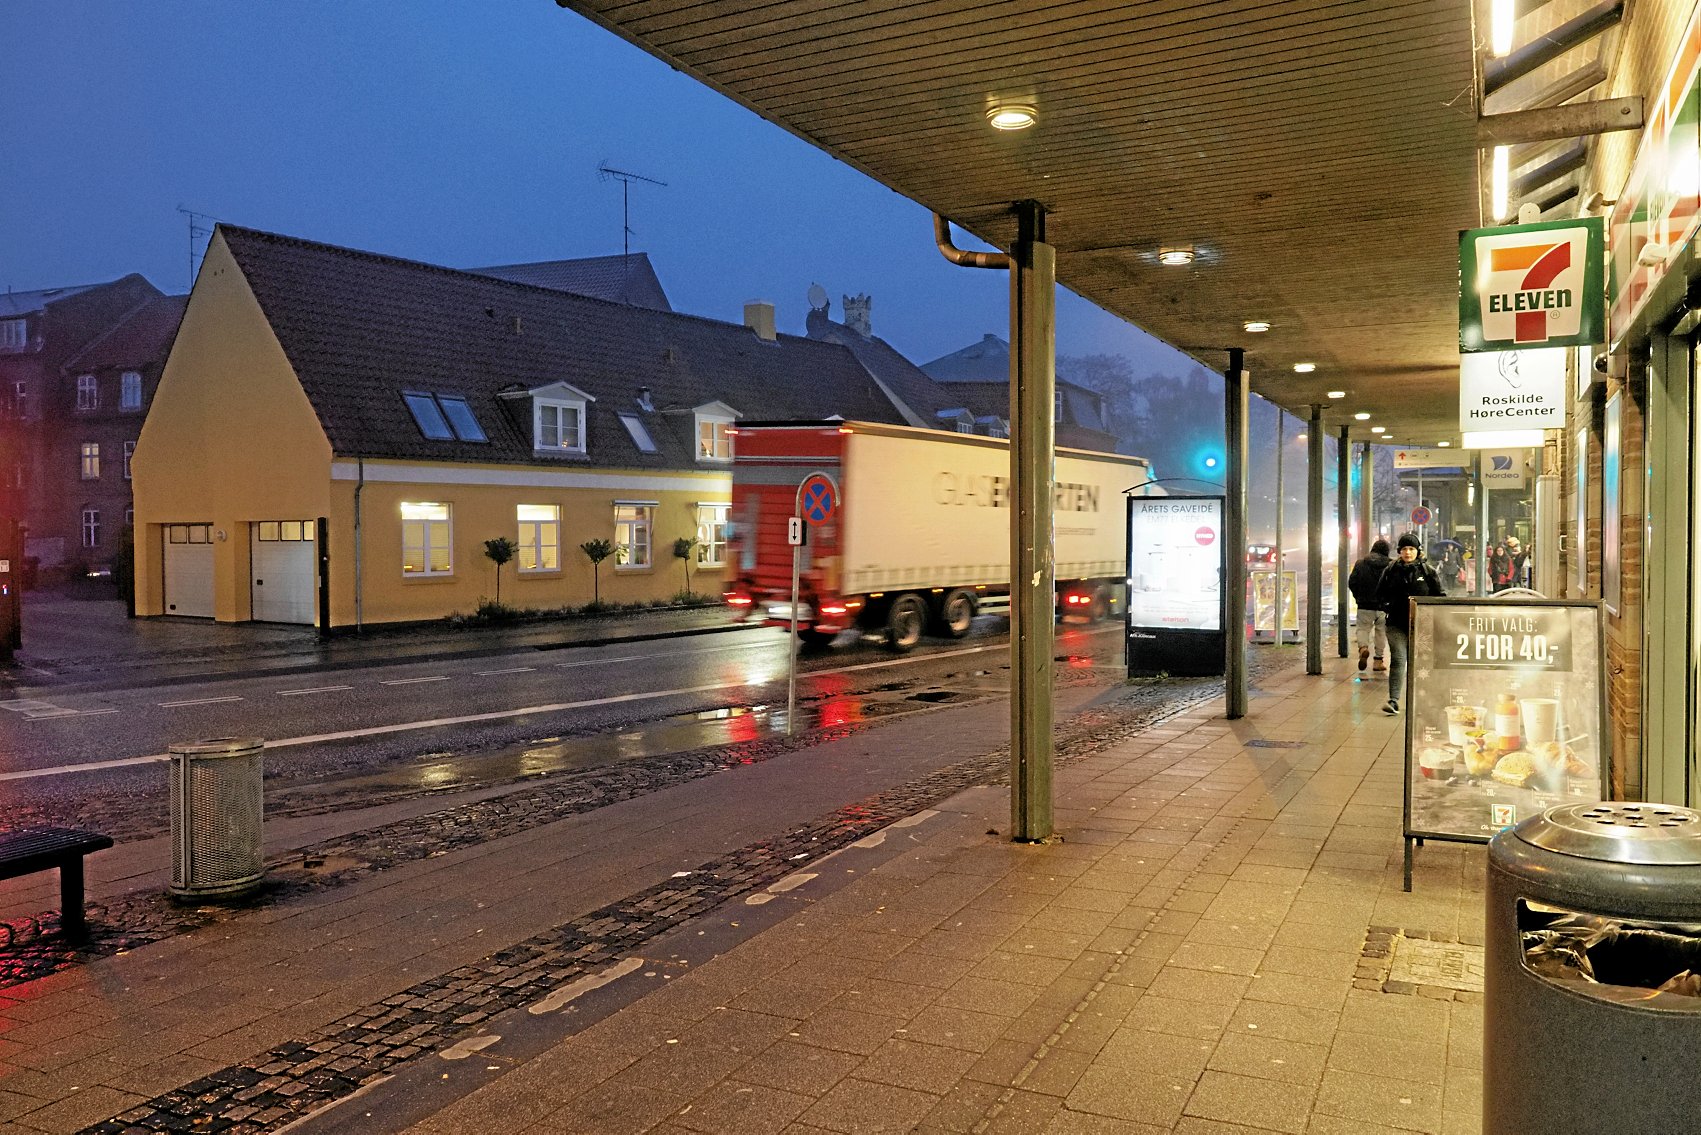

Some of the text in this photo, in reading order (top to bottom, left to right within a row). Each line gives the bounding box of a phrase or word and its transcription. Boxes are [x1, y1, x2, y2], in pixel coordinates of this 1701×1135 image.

[1491, 241, 1571, 342] 7
[1482, 394, 1543, 405] Roskilde
[1470, 407, 1556, 418] HøreCenter
[1141, 502, 1213, 513] ÅRETS GAVEIDÉ
[1469, 617, 1538, 632] FRIT VALG:
[1456, 634, 1559, 664] 2 FOR 40,-
